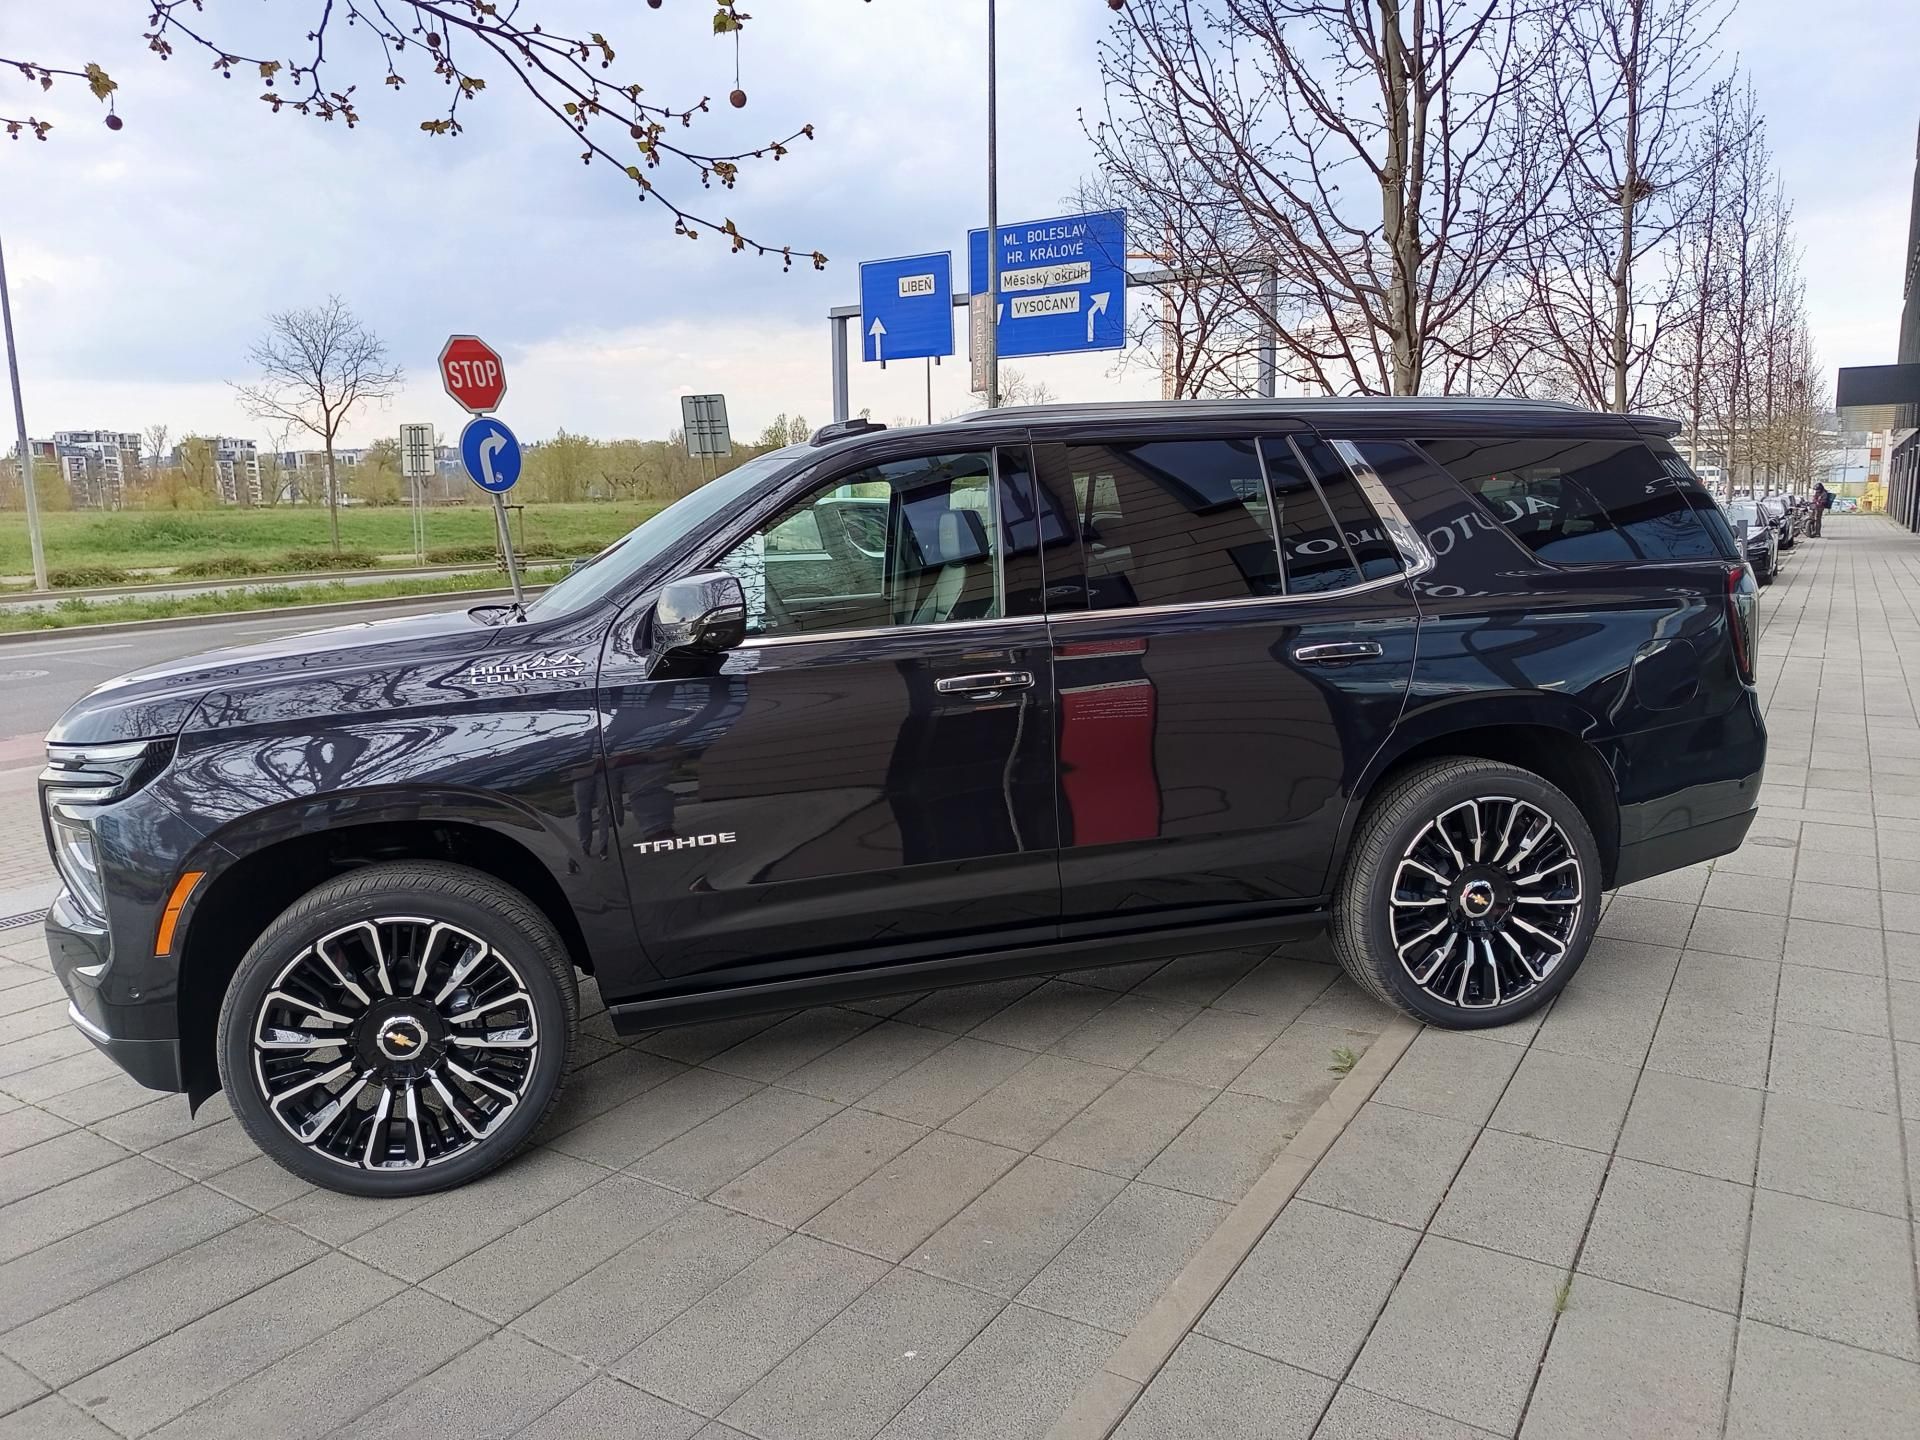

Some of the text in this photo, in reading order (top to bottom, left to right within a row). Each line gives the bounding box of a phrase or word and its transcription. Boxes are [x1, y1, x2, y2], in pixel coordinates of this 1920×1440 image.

[1003, 223, 1087, 246] ML. BOLESLAV
[1007, 240, 1084, 264] HR. KRÁLOVÉ
[1054, 267, 1088, 281] okruh
[901, 276, 932, 293] LIBEŇ
[1014, 296, 1076, 314] VYSOČANY
[448, 360, 497, 388] STOP
[471, 664, 528, 676] HIGH
[471, 667, 584, 685] COUNTRY
[633, 832, 736, 854] TAHOE
